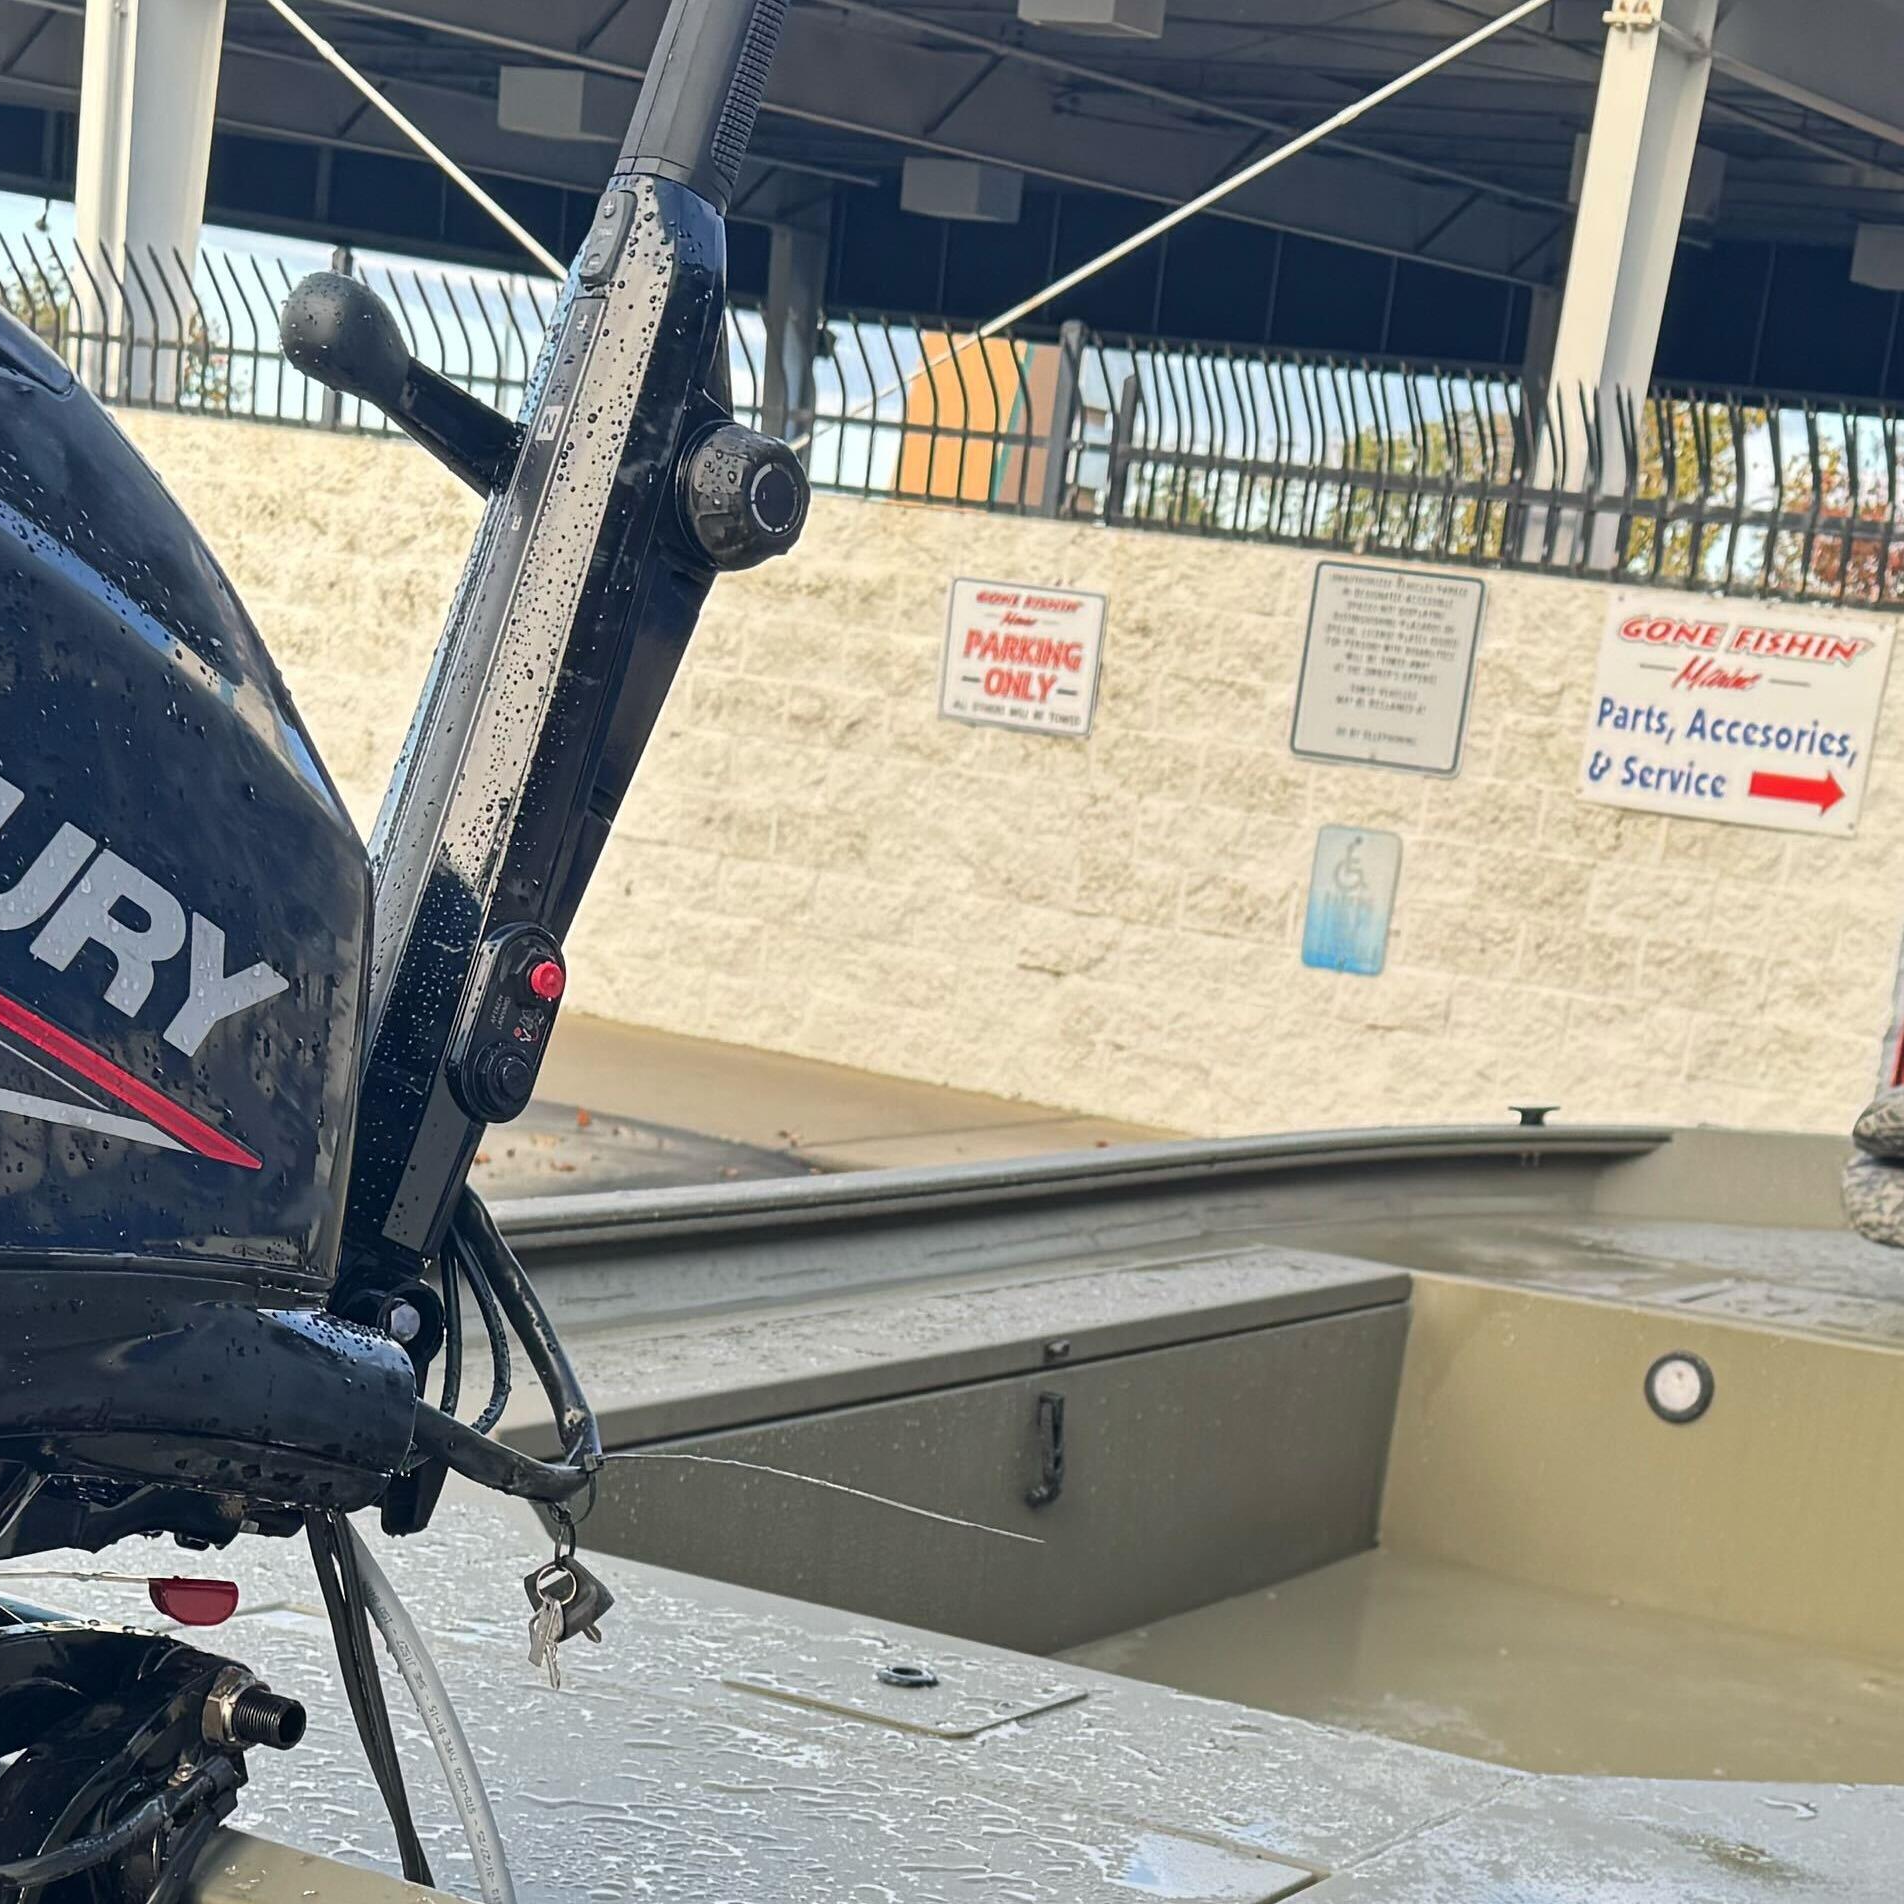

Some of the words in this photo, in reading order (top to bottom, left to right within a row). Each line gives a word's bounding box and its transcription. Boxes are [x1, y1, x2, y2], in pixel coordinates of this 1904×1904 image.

[963, 627, 1084, 672] PARKING
[1619, 616, 1726, 648] GONE
[984, 667, 1057, 704] ONLY
[1596, 696, 1676, 745] Parts,
[1686, 708, 1859, 768] Accesories,
[1588, 750, 1612, 782] &
[1621, 755, 1727, 798] Service
